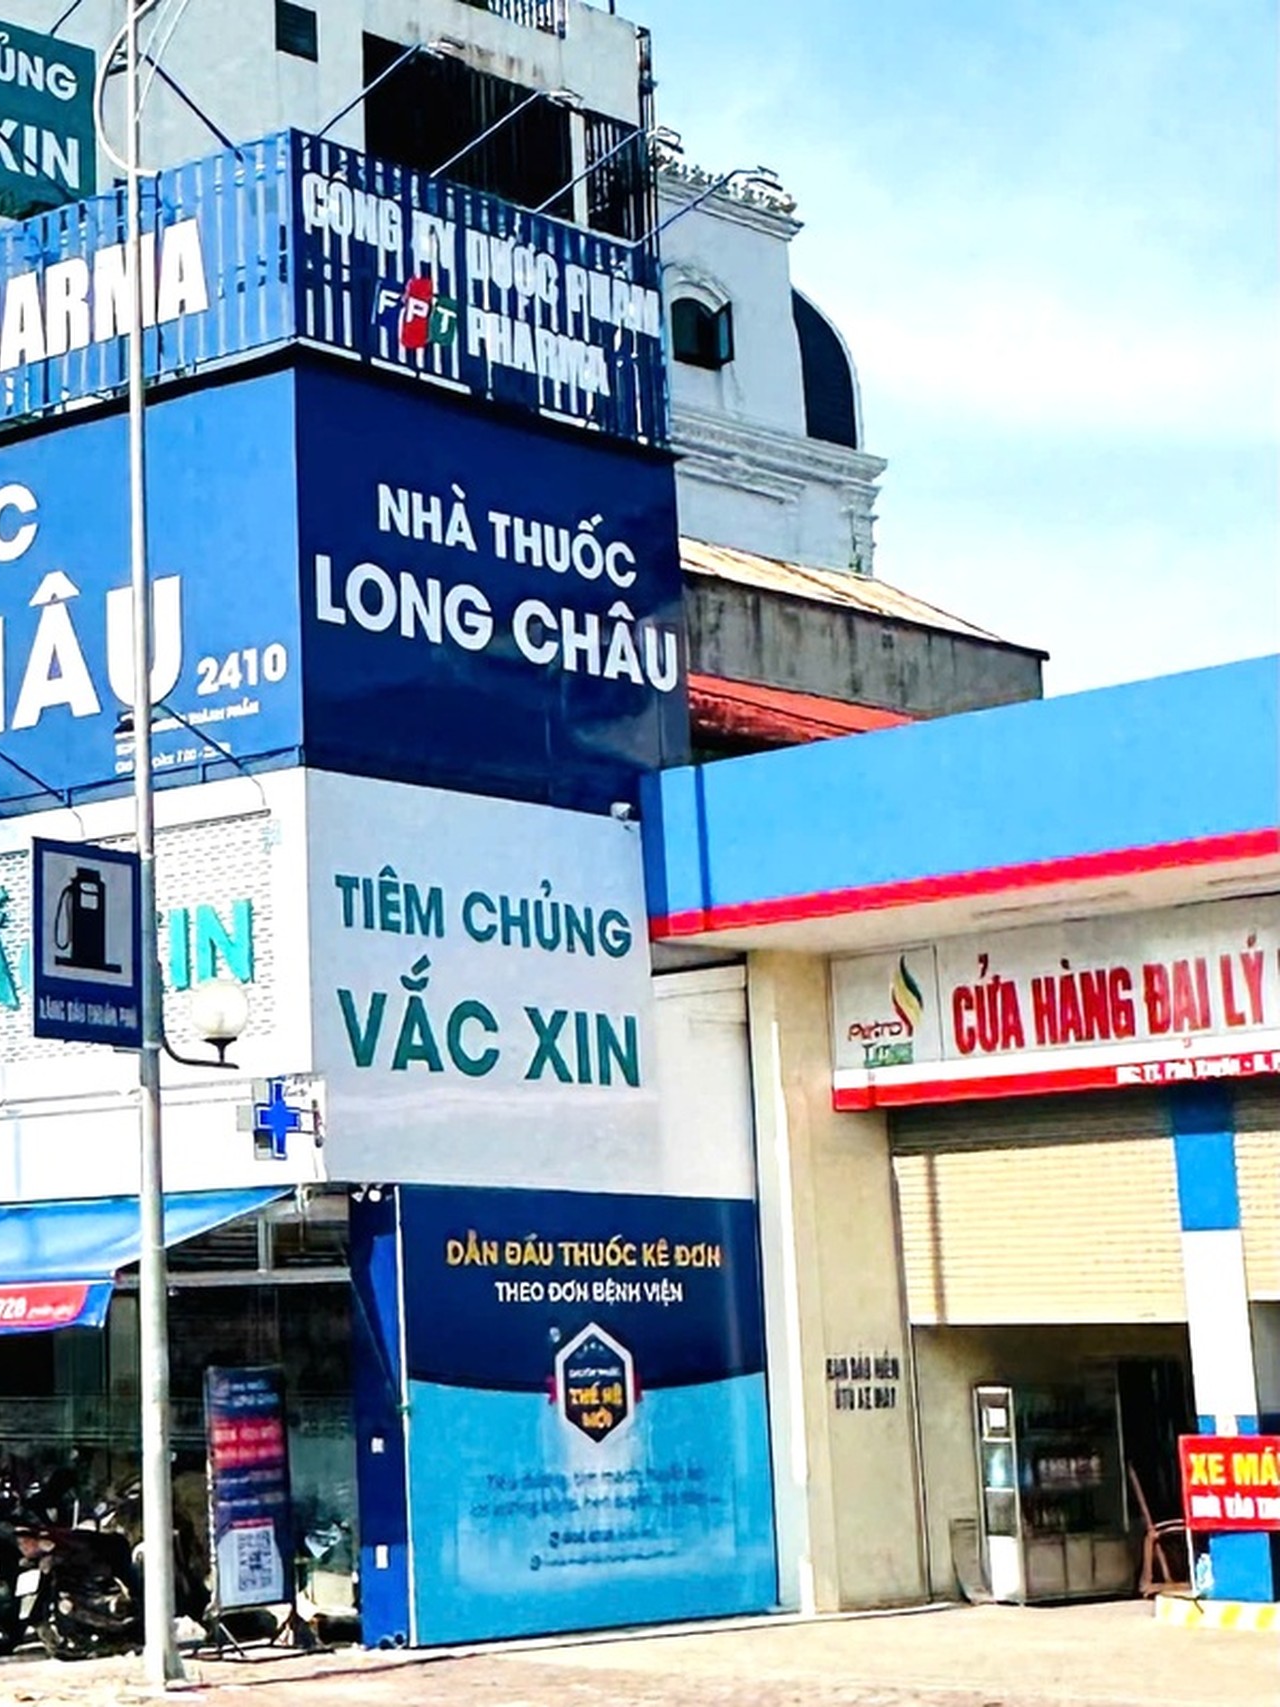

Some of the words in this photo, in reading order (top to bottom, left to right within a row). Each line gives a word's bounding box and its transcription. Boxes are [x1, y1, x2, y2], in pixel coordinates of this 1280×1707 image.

[376, 287, 458, 336] FPT
[378, 483, 477, 552] NHÀ
[488, 513, 637, 588] THUỐC
[196, 643, 288, 696] 2410
[315, 554, 494, 650] LONG
[513, 599, 678, 692] CHÂU
[157, 898, 256, 991] IN
[334, 865, 444, 938] TIÊM
[462, 879, 632, 958] CHỦNG
[336, 954, 500, 1077] VẮC
[524, 1006, 640, 1087] XIN
[952, 953, 1025, 1055] CỬA
[1031, 958, 1135, 1046] HÀNG
[1220, 934, 1265, 1026] LÝ
[495, 1281, 544, 1302] THEO
[643, 1277, 683, 1307] VIỆN
[558, 1234, 637, 1267] THUỐC
[642, 1238, 671, 1267] KÊ
[1189, 1453, 1226, 1486] XE
[1232, 1446, 1280, 1486] MÁ
